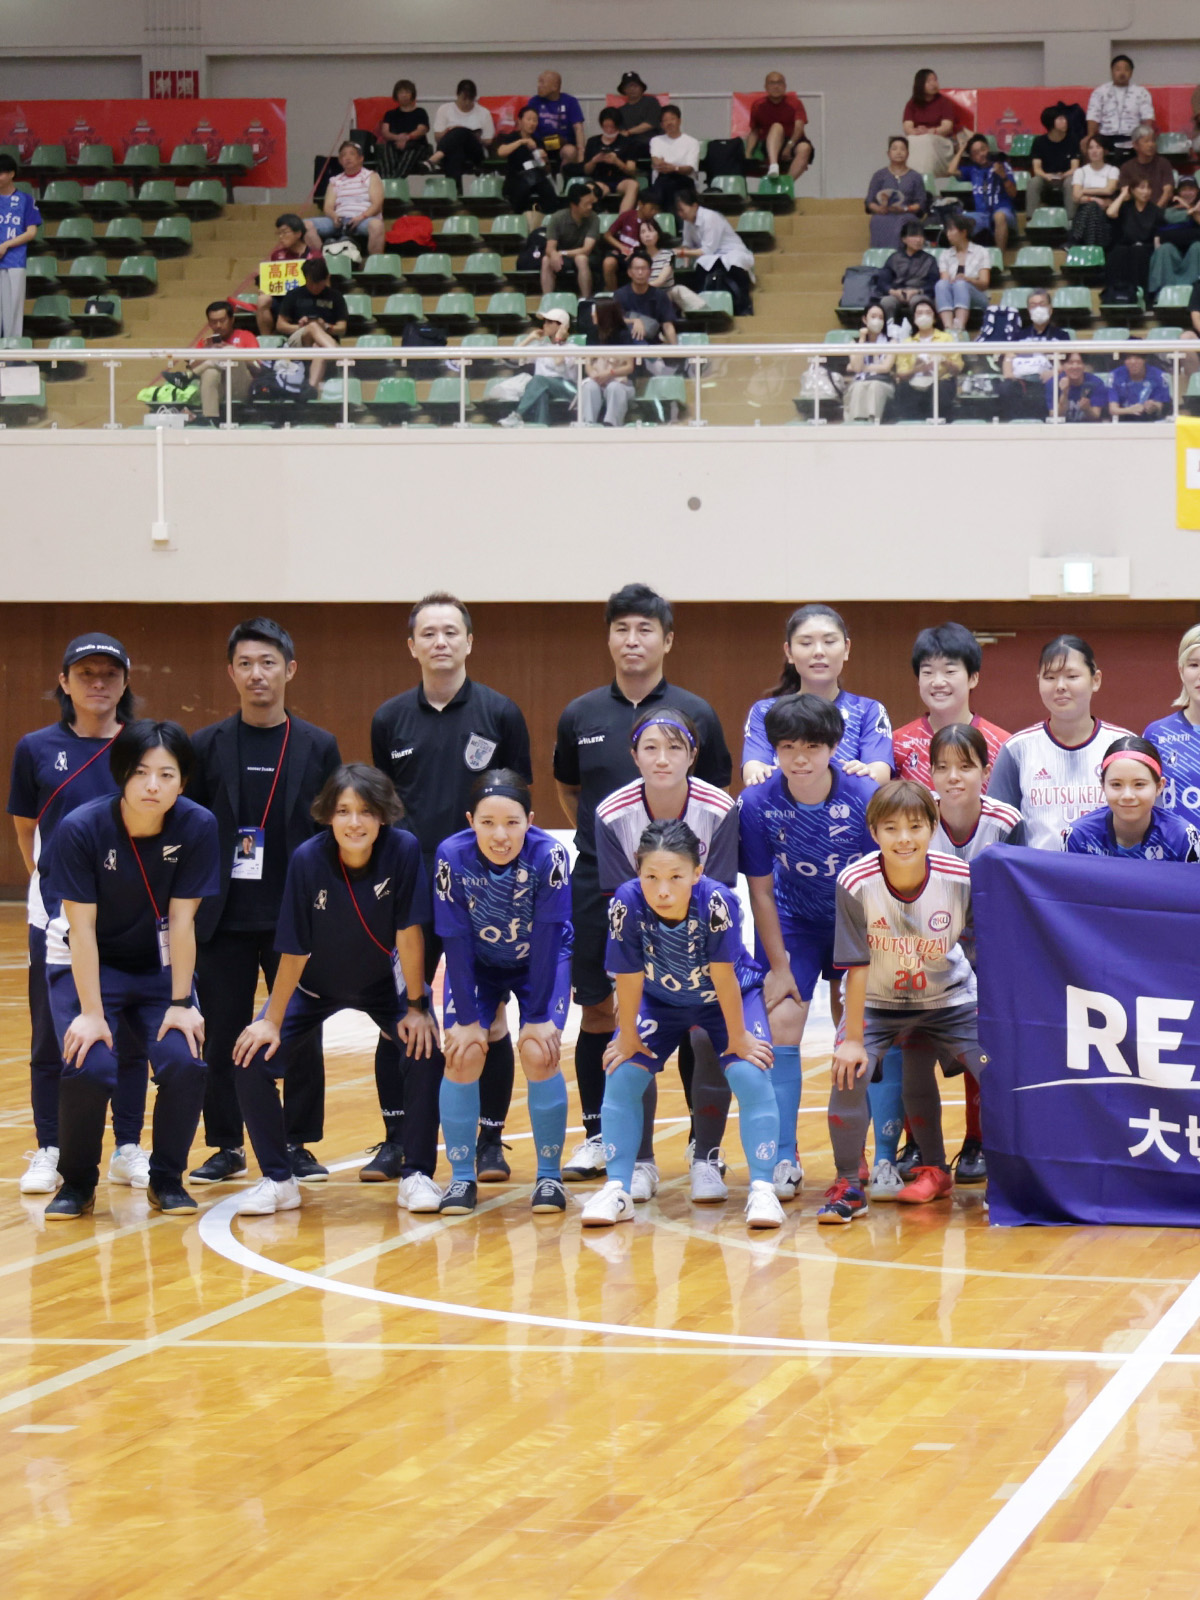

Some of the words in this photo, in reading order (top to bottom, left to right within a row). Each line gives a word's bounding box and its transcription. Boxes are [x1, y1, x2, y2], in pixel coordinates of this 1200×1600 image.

[1030, 786, 1075, 806] RYUTSU
[914, 936, 948, 955] EIZAI
[894, 970, 928, 991] 20
